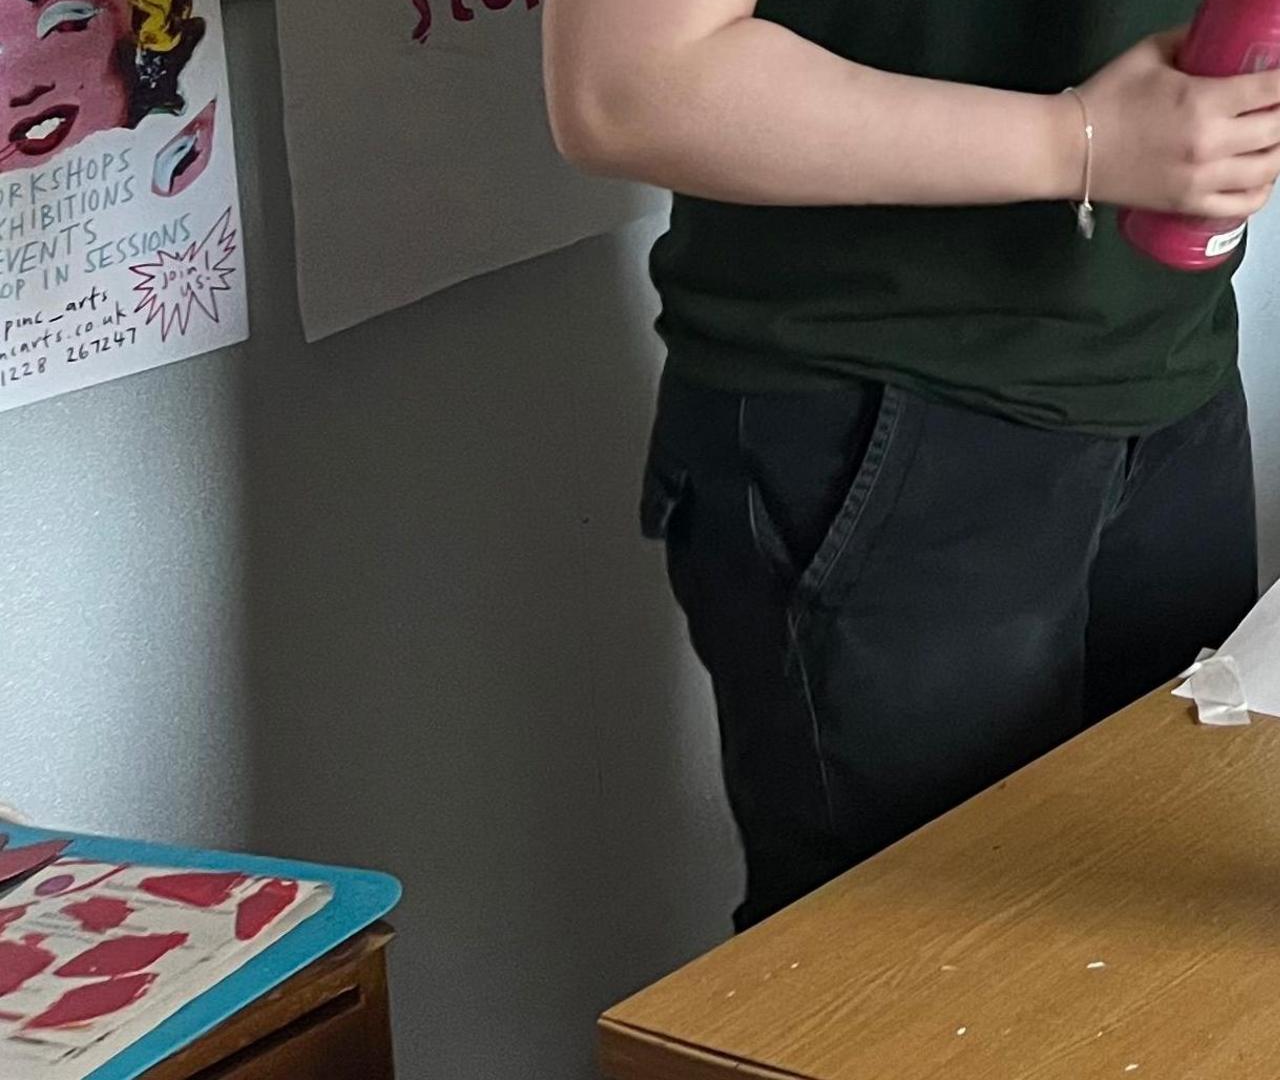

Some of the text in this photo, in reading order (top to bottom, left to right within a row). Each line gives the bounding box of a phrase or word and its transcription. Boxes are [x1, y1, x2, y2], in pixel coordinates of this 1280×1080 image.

[44, 262, 70, 290] IN
[85, 212, 193, 273] SESSIONS
[66, 327, 137, 363] 267247
